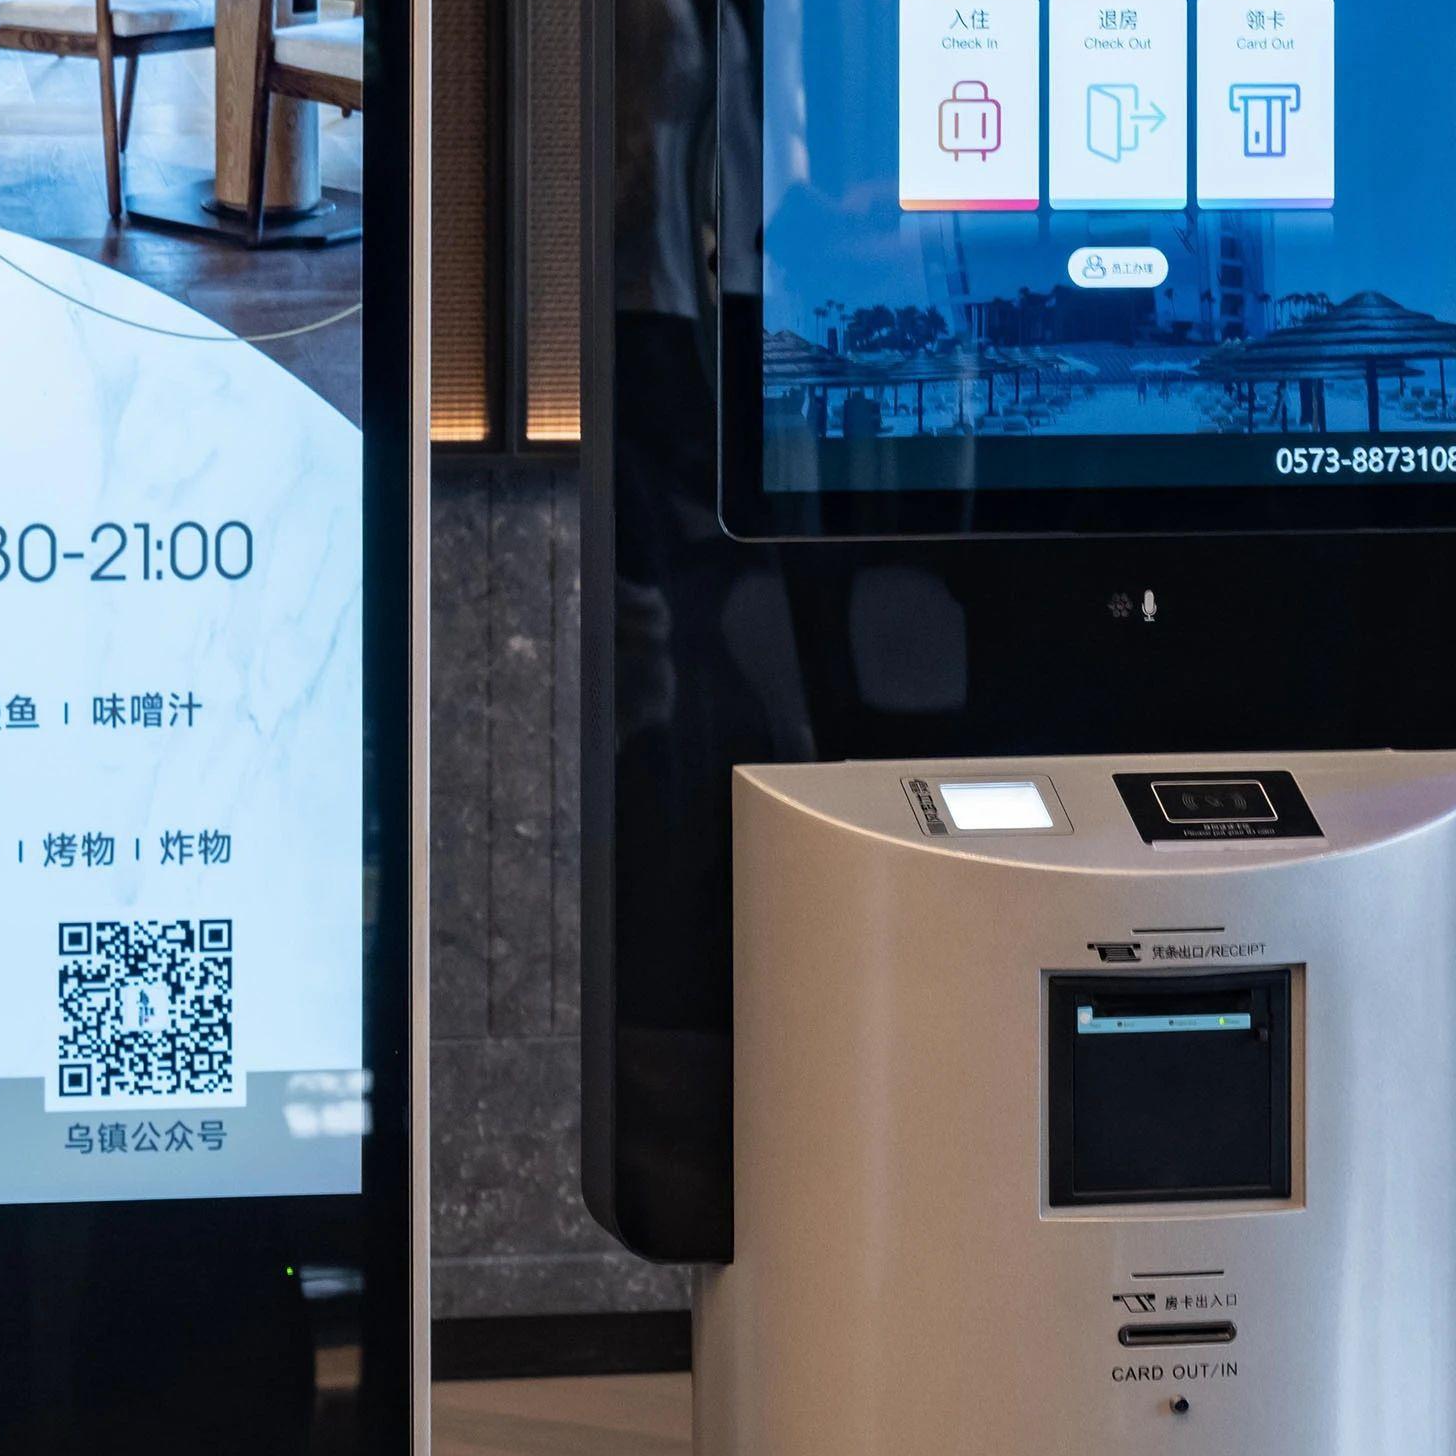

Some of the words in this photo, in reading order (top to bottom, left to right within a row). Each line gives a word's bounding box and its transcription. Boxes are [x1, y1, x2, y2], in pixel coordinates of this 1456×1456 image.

[949, 8, 990, 31] 入住
[1099, 9, 1138, 31] 退房
[1246, 9, 1286, 31] 领卡
[941, 36, 982, 50] Check
[987, 36, 999, 50] In
[1083, 36, 1124, 51] Check
[1129, 36, 1152, 50] Out
[1236, 37, 1270, 51] Card
[1274, 36, 1295, 50] Out
[91, 691, 204, 729] 味噌汁
[42, 831, 116, 869] 烤物
[159, 828, 233, 866] 炸物
[64, 1120, 228, 1155] 乌镇公众号
[1165, 1293, 1238, 1312] 房卡出入口
[1111, 1364, 1164, 1383] CARD
[1172, 1361, 1239, 1381] OUT/IN
